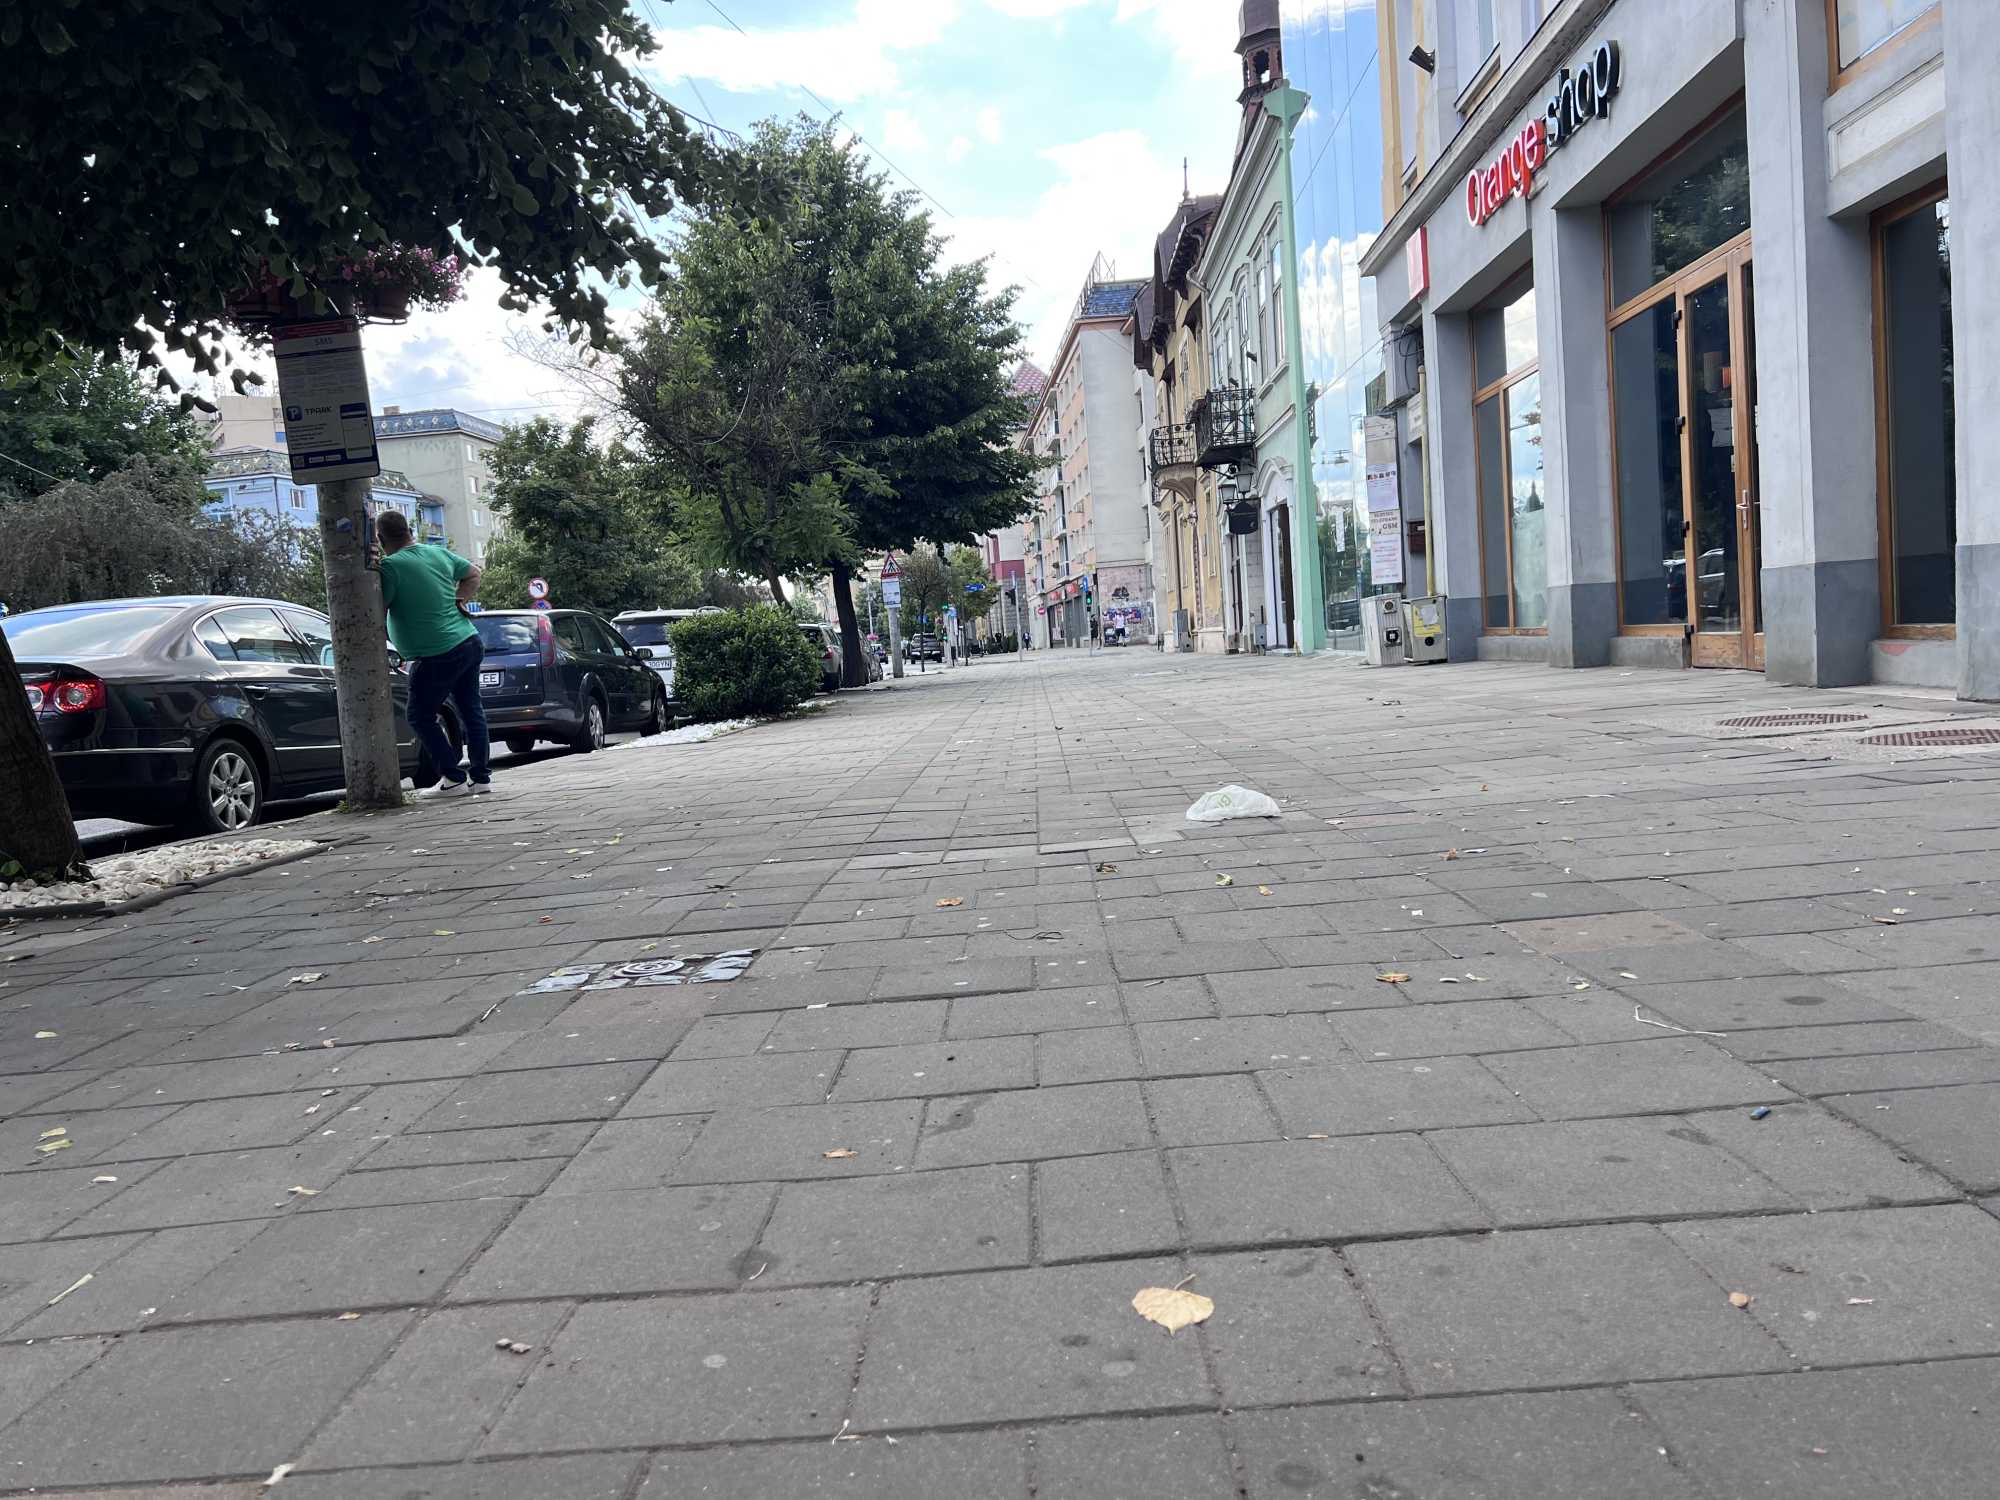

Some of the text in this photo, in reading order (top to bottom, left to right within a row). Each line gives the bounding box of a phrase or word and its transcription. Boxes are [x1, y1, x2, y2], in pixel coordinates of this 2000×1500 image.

[1466, 40, 1619, 227] Orange shop
[480, 673, 497, 687] EE
